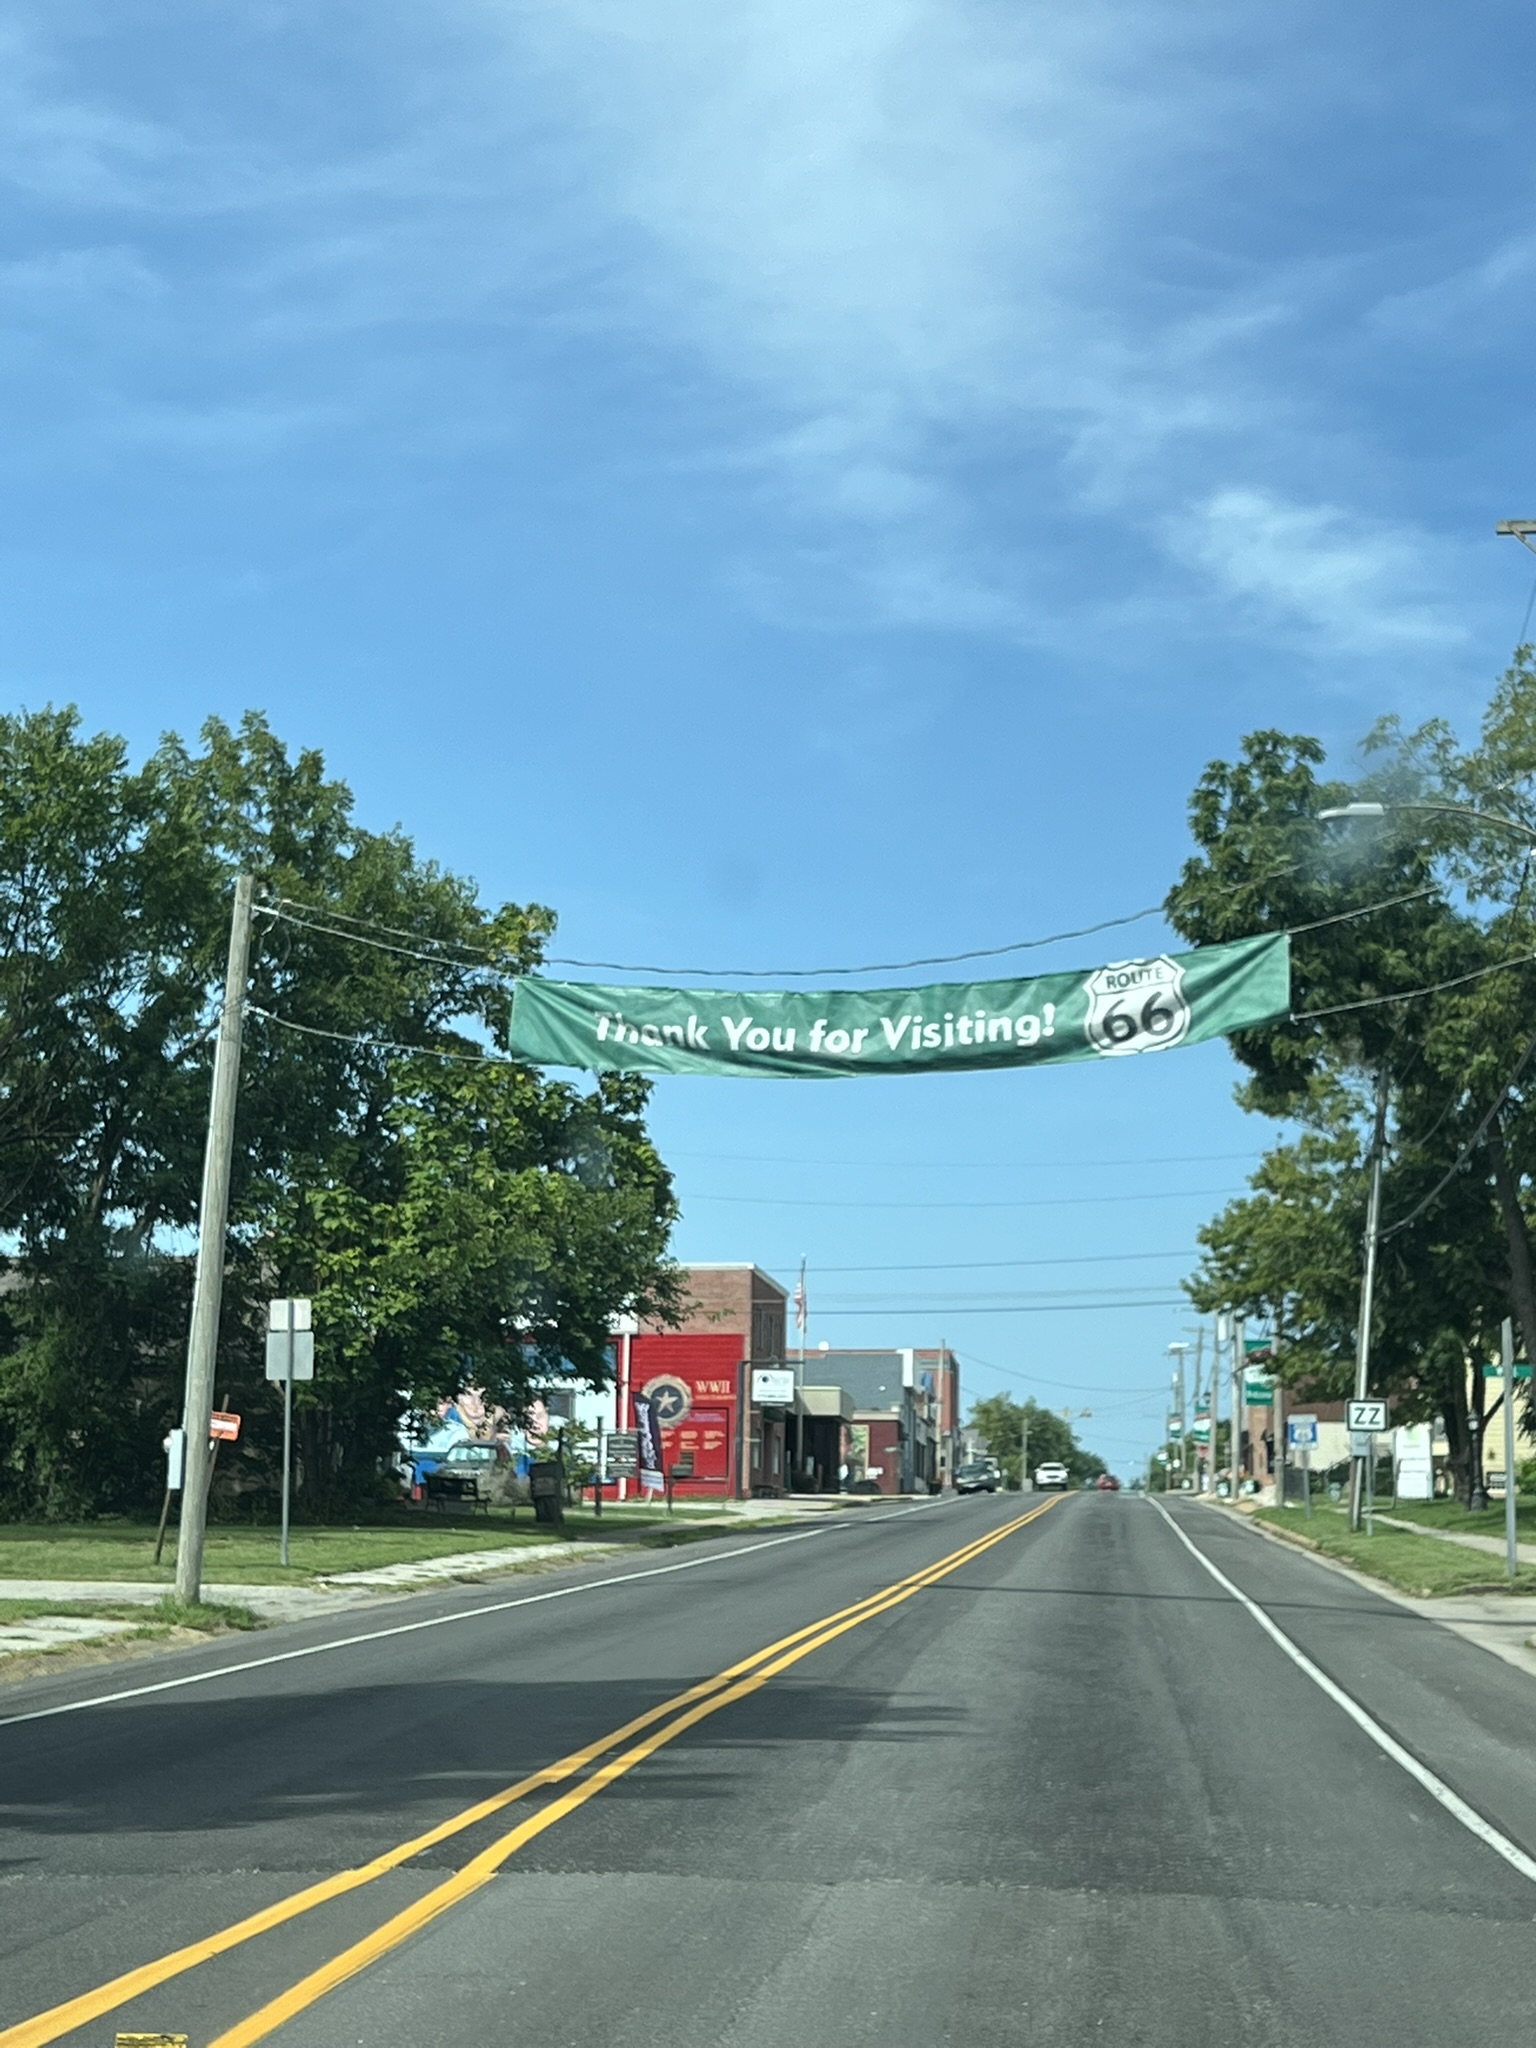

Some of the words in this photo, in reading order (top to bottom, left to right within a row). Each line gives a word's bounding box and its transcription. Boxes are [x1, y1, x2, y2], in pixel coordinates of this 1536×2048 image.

[1107, 966, 1165, 990] ROUTE
[595, 1012, 710, 1050] Thank
[720, 1015, 797, 1052] You
[808, 1018, 869, 1055] for
[880, 1002, 1056, 1052] Visiting!
[1102, 991, 1175, 1043] 66
[695, 1380, 731, 1394] WWII
[1353, 1406, 1381, 1425] ZZ
